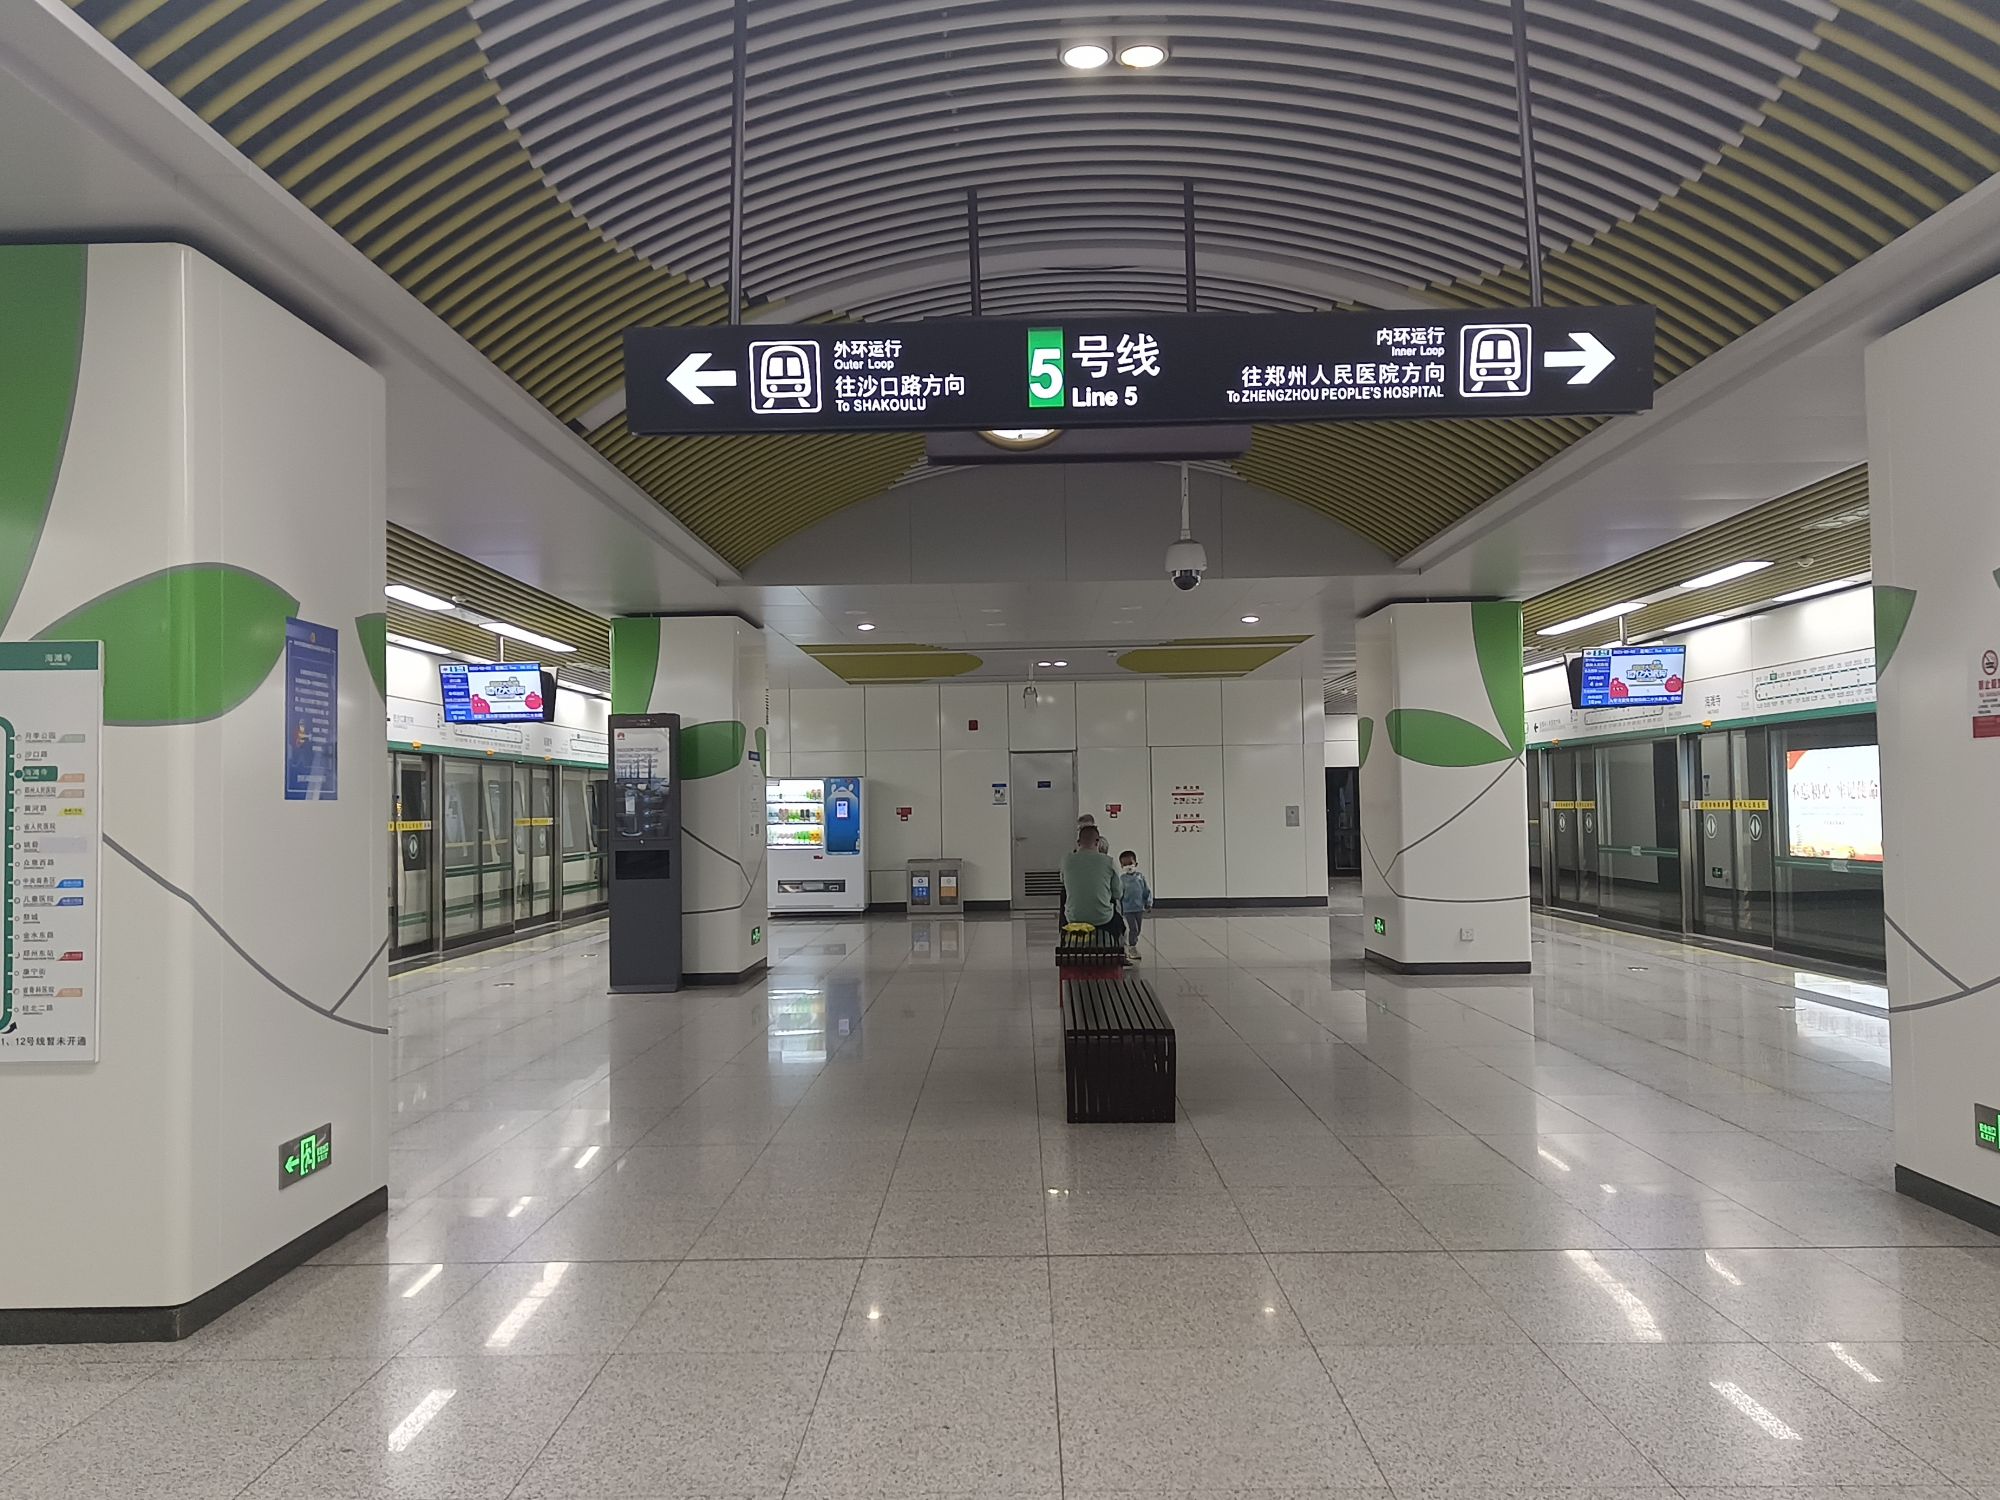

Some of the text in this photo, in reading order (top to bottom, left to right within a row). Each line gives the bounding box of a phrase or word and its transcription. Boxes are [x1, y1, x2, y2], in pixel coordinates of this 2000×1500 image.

[1376, 326, 1445, 346] 内环运行
[833, 339, 902, 358] 外环运行
[1391, 345, 1445, 358] Inner Loop
[833, 358, 895, 370] Outer Loop
[1029, 333, 1161, 399] 5 号线
[1241, 361, 1445, 388] 往郑州人民医院方向
[834, 373, 965, 398] 往沙口路方向
[1227, 385, 1444, 403] To ZHENGZHOU PEOPLE'S HOSPITAL
[835, 398, 927, 412] To SHAKOULU
[1072, 386, 1138, 407] Line 5
